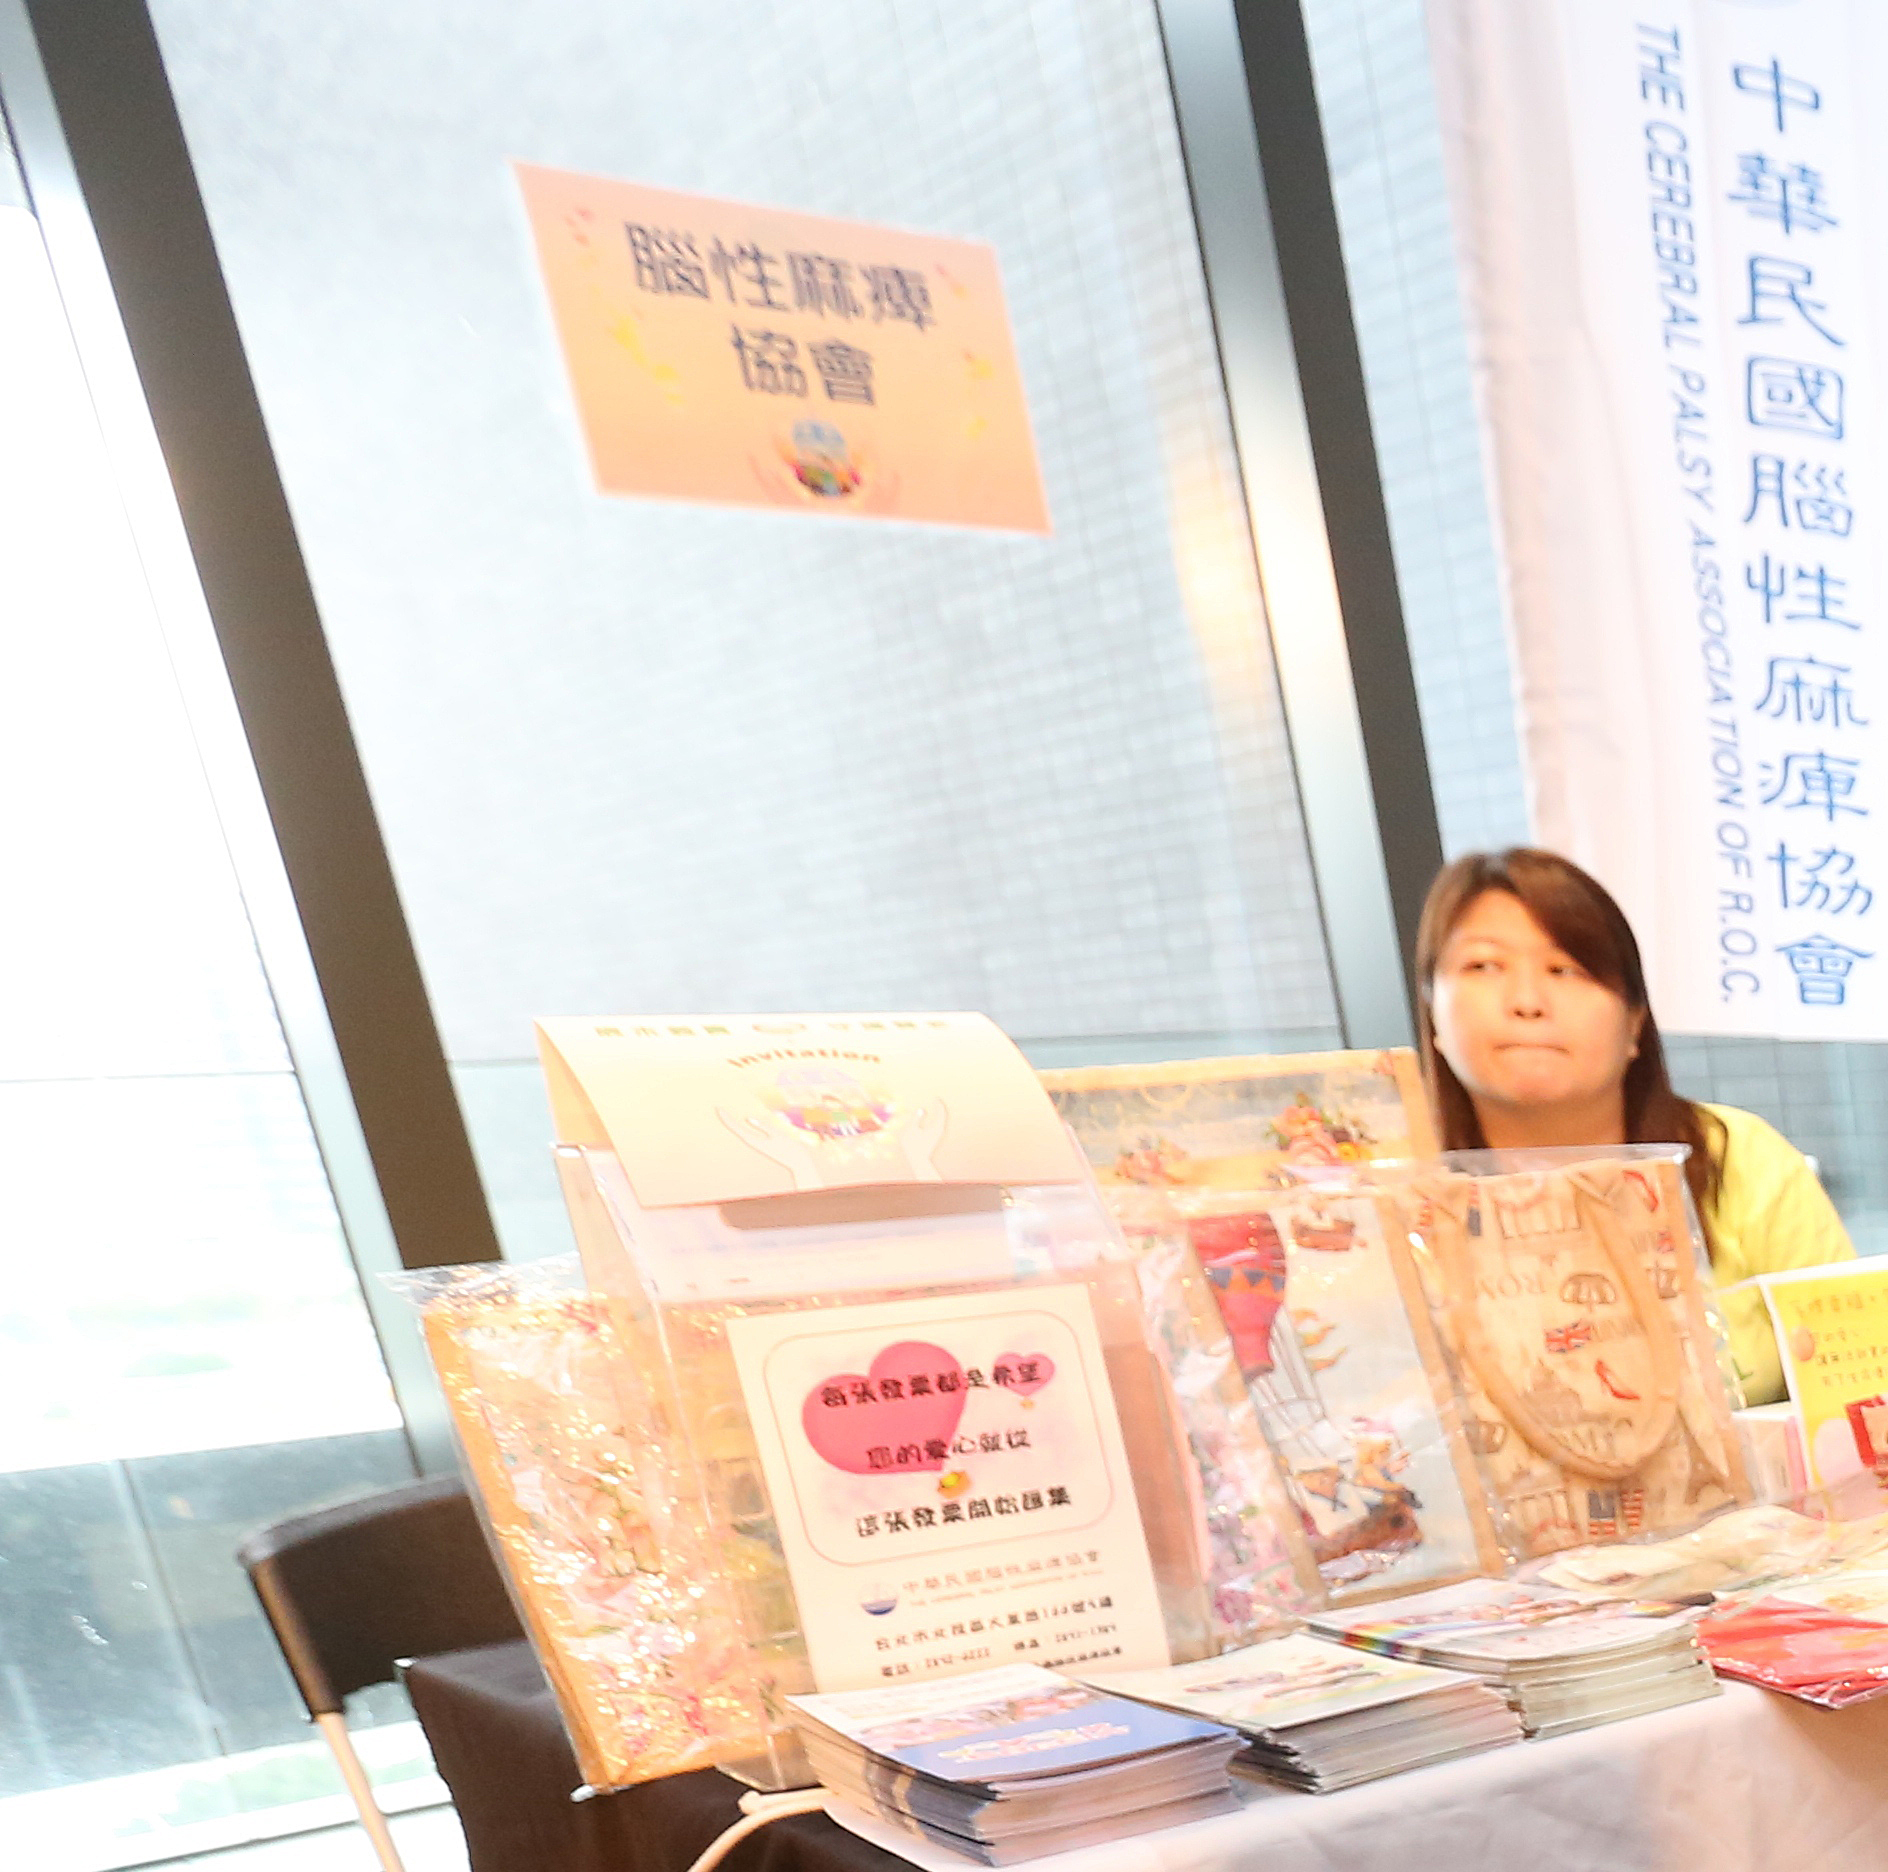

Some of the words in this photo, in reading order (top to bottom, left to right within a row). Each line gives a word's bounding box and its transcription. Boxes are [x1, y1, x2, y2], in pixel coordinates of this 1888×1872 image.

[1635, 21, 1686, 113] THE
[622, 219, 938, 333] 腦性麻痺
[1643, 120, 1702, 351] CEREBRAL
[730, 322, 878, 407] 協會
[1668, 362, 1716, 518] PALSY
[1725, 55, 1877, 1007] 中華民國腦性麻痺協會
[1688, 518, 1745, 811] ASSOCIATION
[1716, 820, 1755, 880] OF
